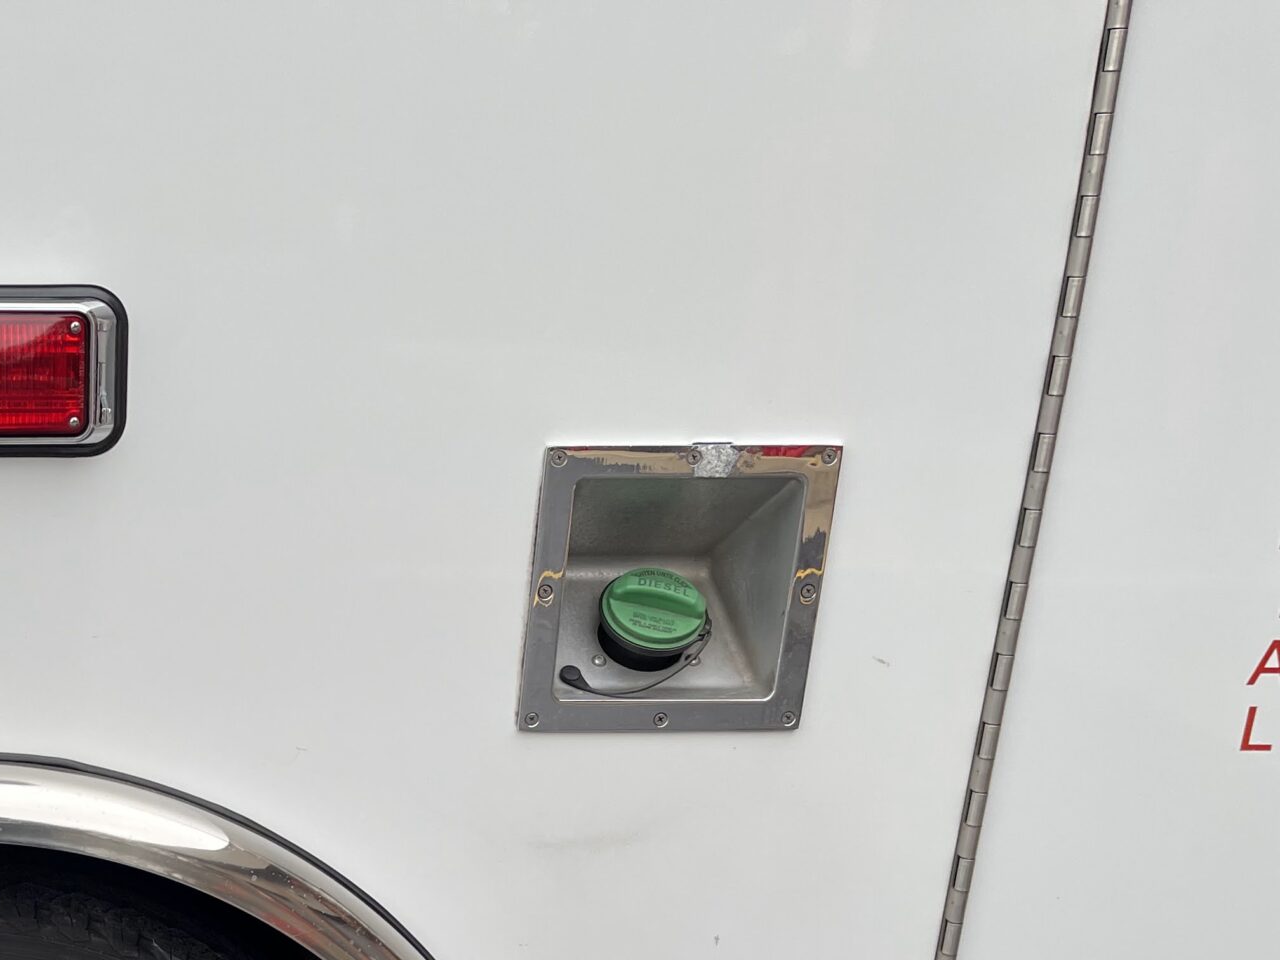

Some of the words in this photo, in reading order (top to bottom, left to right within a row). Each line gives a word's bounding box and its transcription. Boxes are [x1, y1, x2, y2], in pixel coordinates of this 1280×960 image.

[638, 577, 689, 597] DIESEL
[1246, 640, 1280, 685] A
[1240, 706, 1273, 751] L
